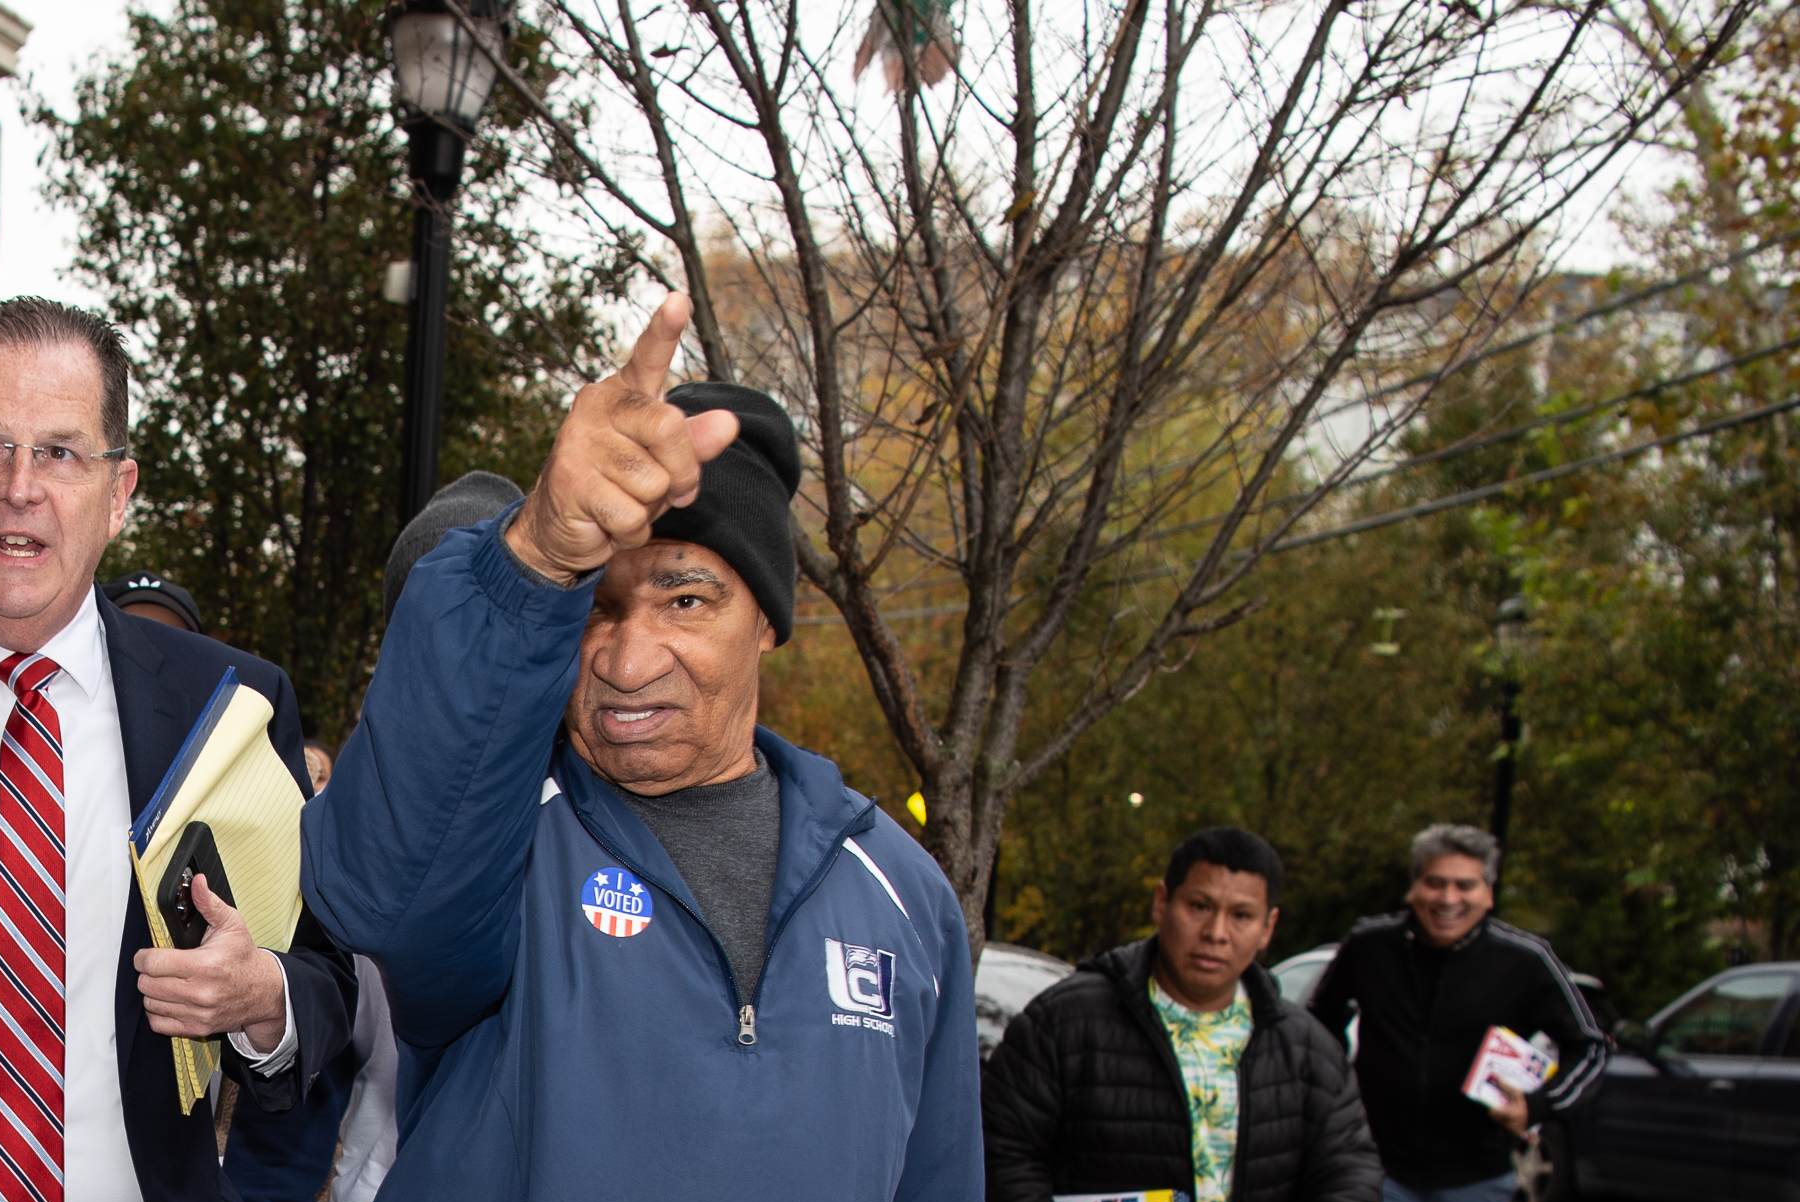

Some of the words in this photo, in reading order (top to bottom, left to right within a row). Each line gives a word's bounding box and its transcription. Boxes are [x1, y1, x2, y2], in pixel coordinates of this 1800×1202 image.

[616, 872, 623, 890] I
[593, 886, 643, 914] VOTED
[831, 1013, 862, 1026] HIGH
